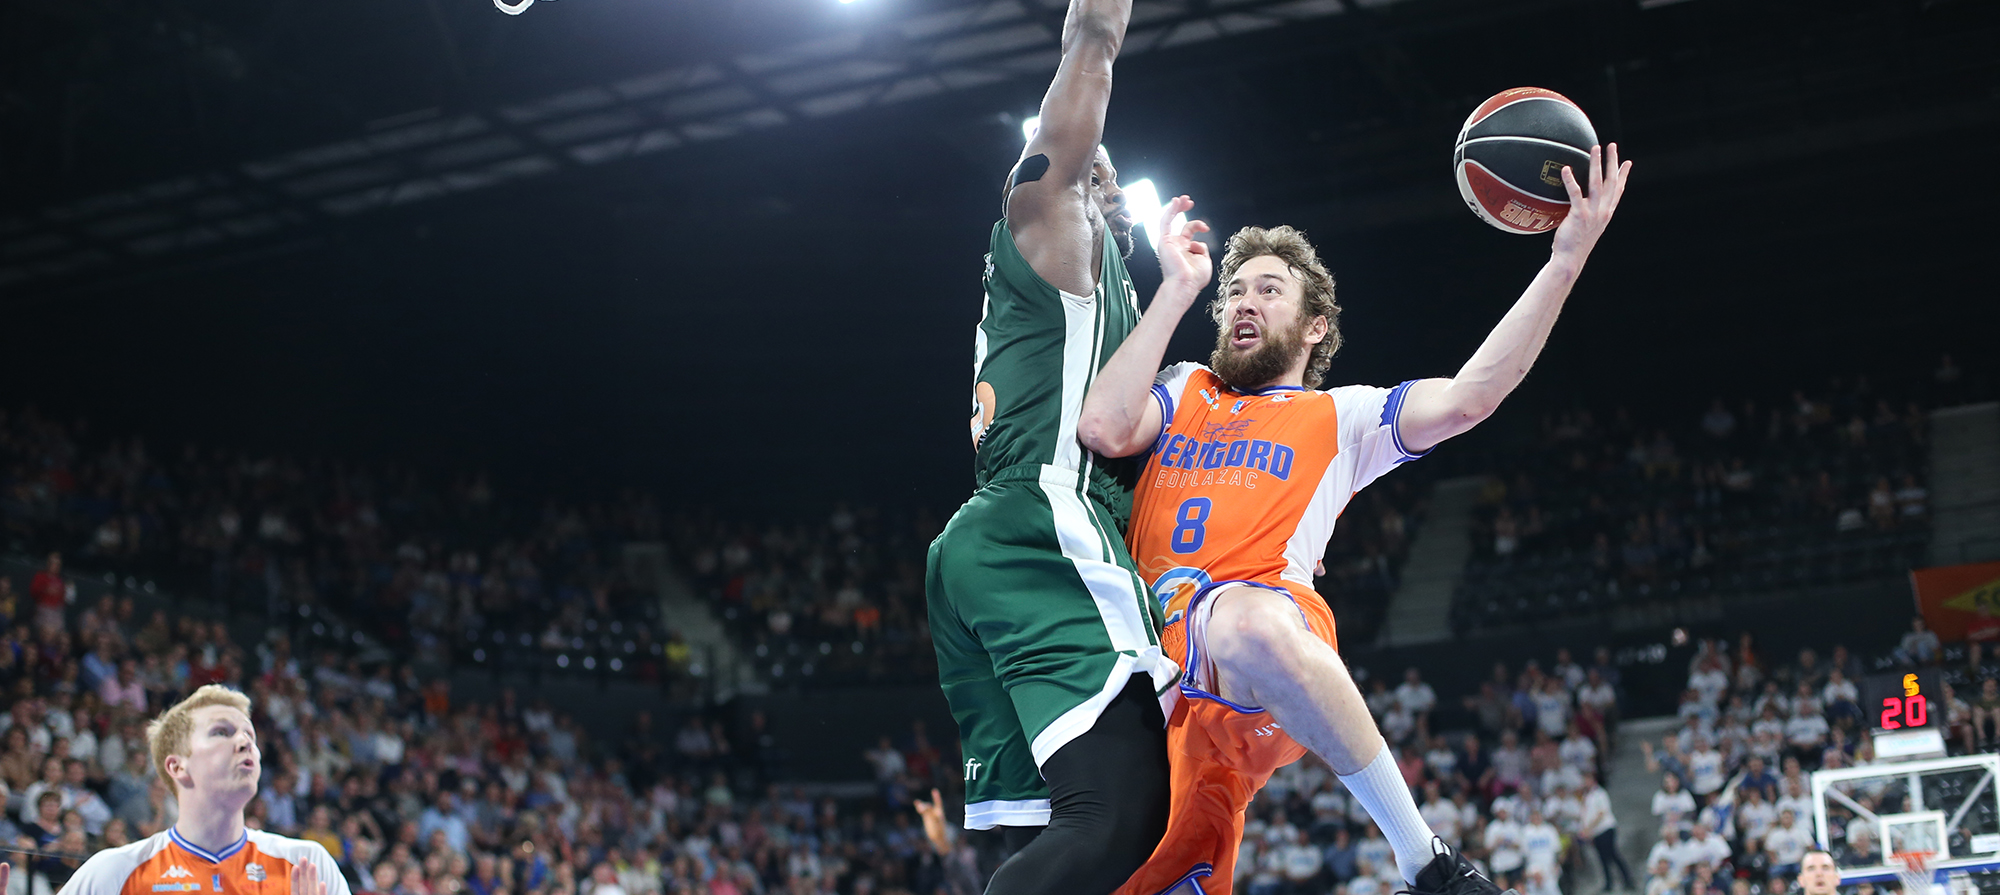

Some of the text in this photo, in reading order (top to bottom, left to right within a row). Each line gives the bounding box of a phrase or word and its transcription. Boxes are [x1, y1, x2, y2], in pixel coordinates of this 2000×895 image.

[1500, 202, 1551, 230] LNB
[1170, 496, 1212, 555] 8
[1881, 694, 1927, 730] 20
